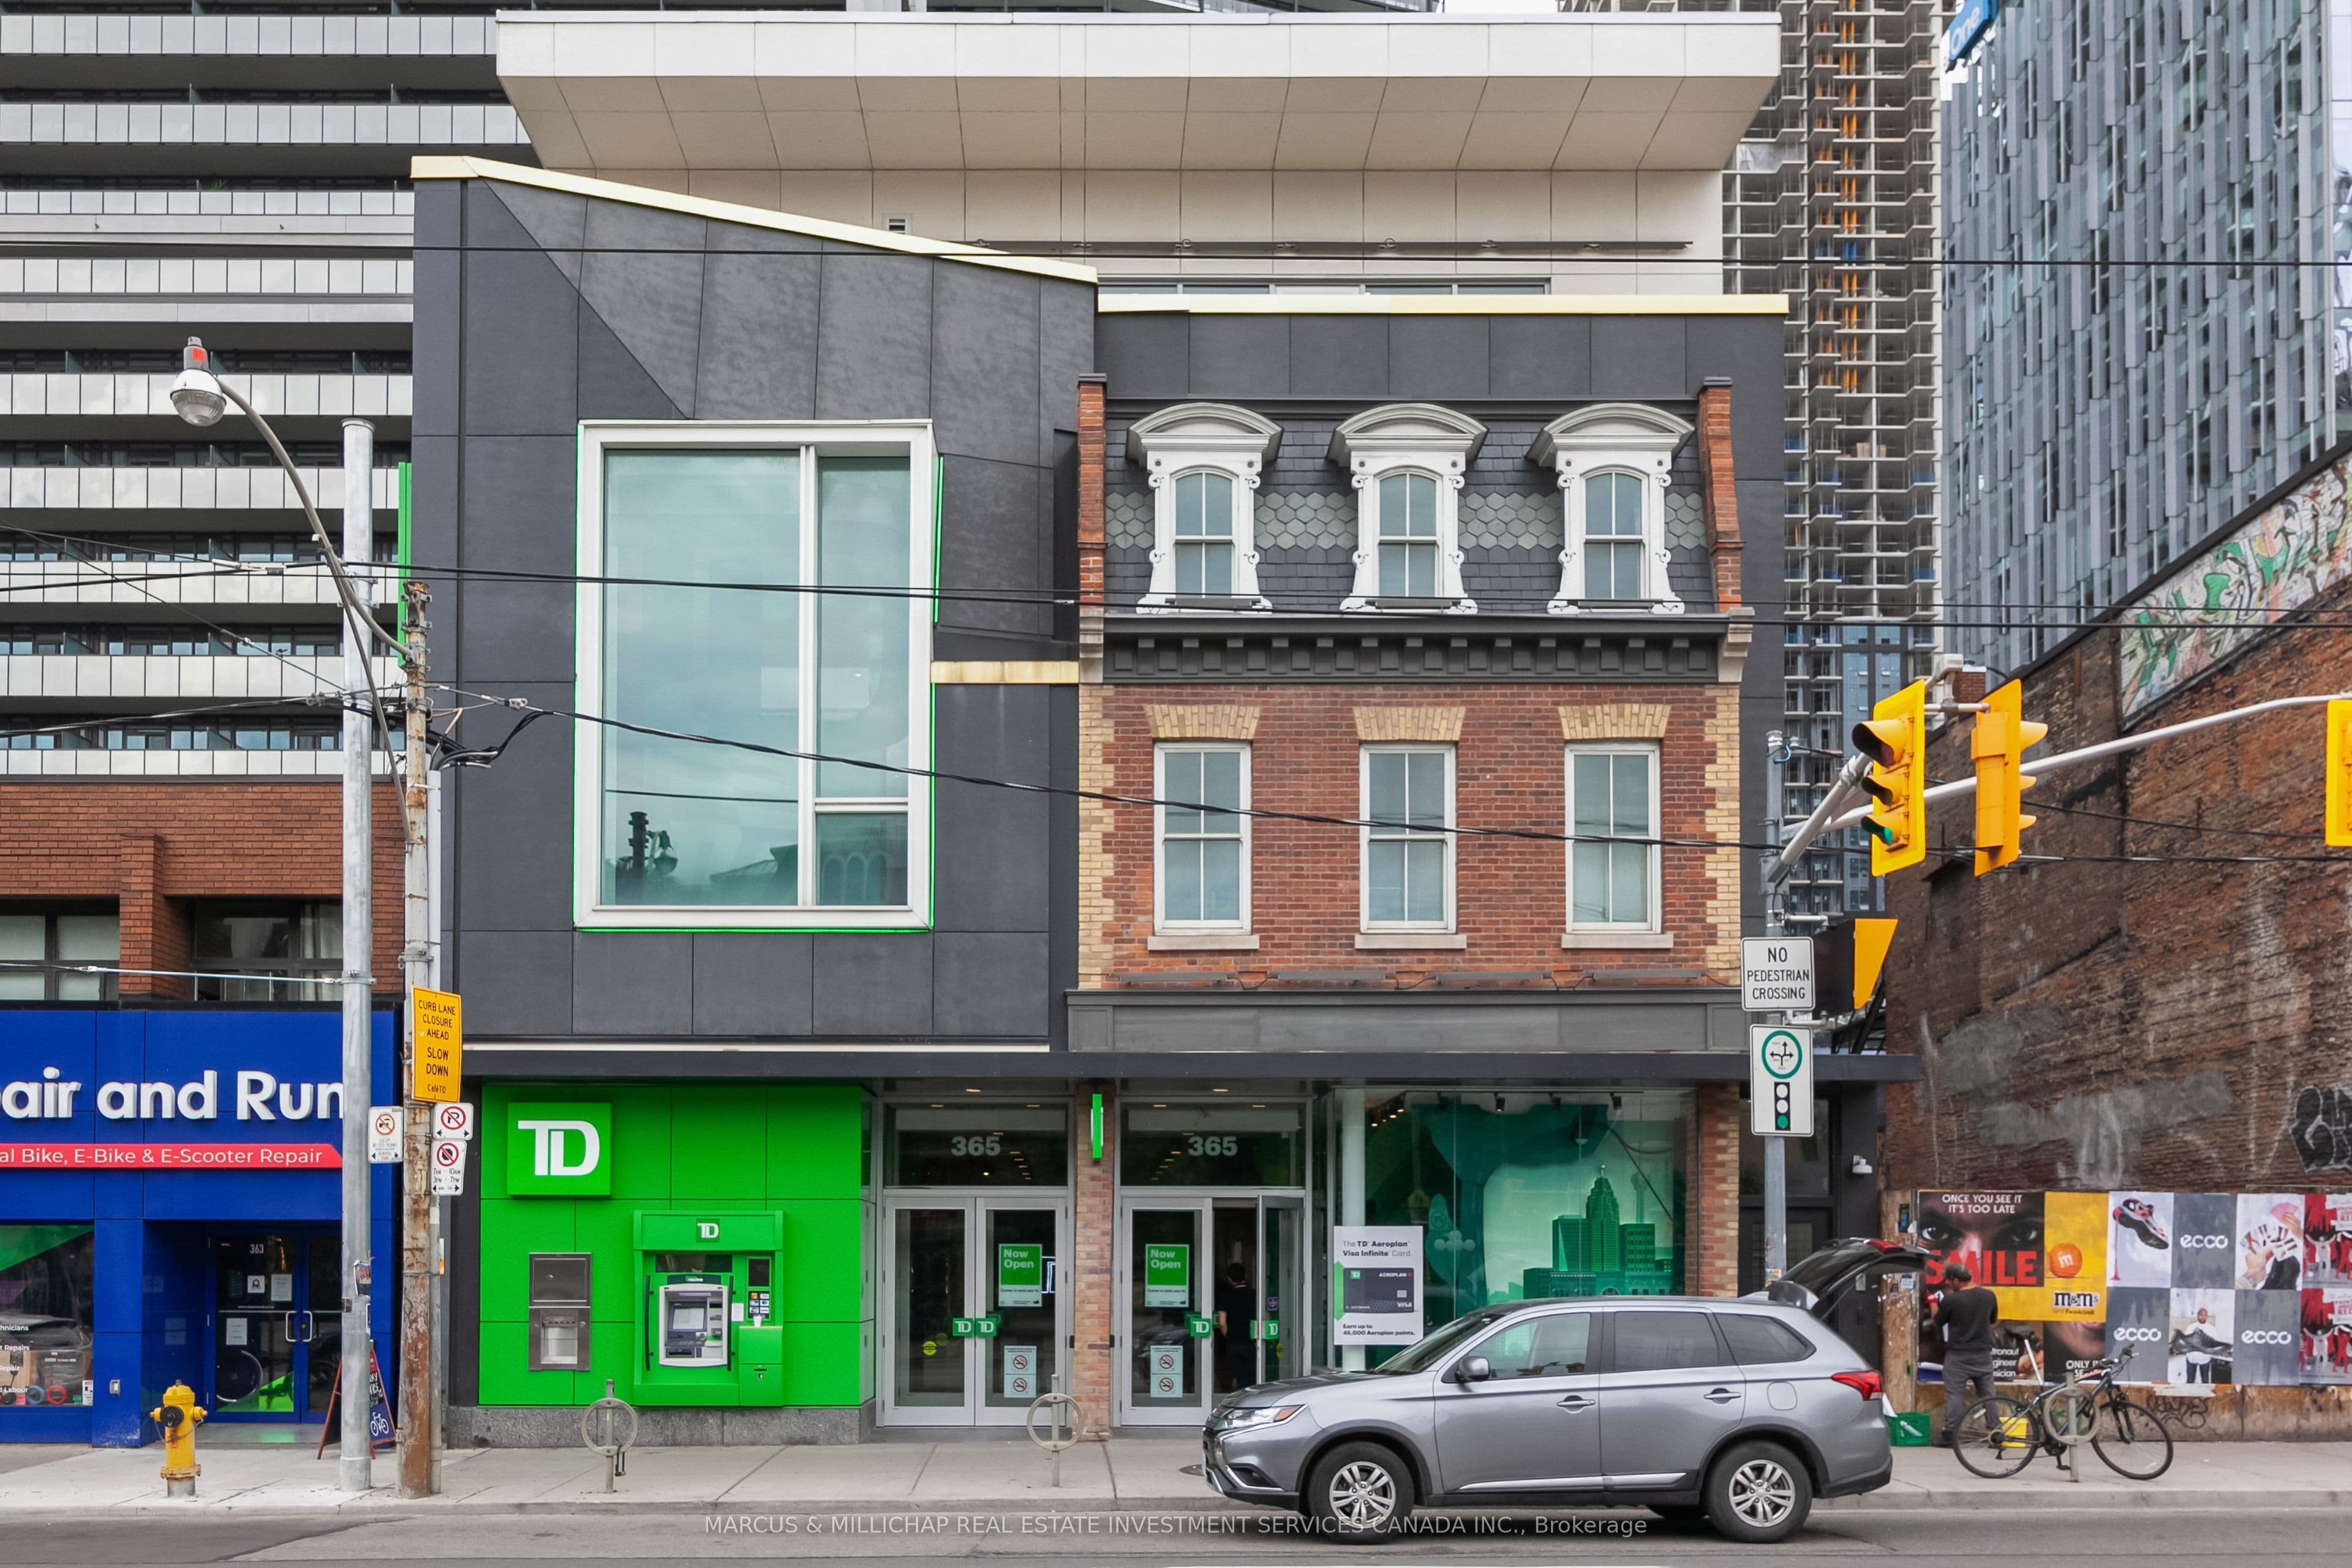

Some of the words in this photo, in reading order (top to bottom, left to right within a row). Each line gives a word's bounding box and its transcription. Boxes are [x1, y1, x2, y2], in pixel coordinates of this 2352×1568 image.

[1768, 948, 1787, 962] NO
[1747, 970, 1809, 982] PEDESTRIAN
[1752, 987, 1805, 1000] CROSSING
[418, 1000, 436, 1011] CURB
[438, 1005, 456, 1016] LANE
[423, 1014, 453, 1028] CLOSURE
[426, 1028, 449, 1040] AHEAD
[427, 1047, 448, 1060] SLOW
[426, 1063, 448, 1077] DOWN
[0, 1066, 81, 1118] air
[97, 1070, 217, 1119] and
[237, 1070, 343, 1120] Run
[518, 1120, 600, 1175] TD
[951, 1136, 1001, 1156] 365
[1188, 1136, 1238, 1156] 365
[22, 1149, 68, 1165] Bike,
[74, 1149, 135, 1163] E-Bike
[142, 1149, 154, 1163] &
[161, 1149, 252, 1163] E-Scooter
[260, 1149, 322, 1166] Repair
[1942, 1194, 1969, 1203] ONCE
[1973, 1194, 1993, 1203] YOU
[1996, 1194, 2011, 1204] SEE
[2014, 1195, 2022, 1204] IT
[1948, 1205, 1964, 1213] IT'S
[1968, 1205, 1990, 1213] TOO
[1994, 1205, 2015, 1213] LATE
[697, 1223, 719, 1238] TD
[2180, 1234, 2228, 1249] ecco
[250, 1244, 264, 1254] 363
[1004, 1249, 1029, 1258] Now
[1151, 1249, 1175, 1258] Now
[1004, 1259, 1034, 1270] Open
[1151, 1259, 1181, 1270] Open
[955, 1321, 971, 1333] TD
[978, 1321, 994, 1333] TD
[1193, 1321, 1210, 1333] TD
[1268, 1324, 1278, 1335] TD
[2113, 1327, 2162, 1341] ecco
[2241, 1330, 2292, 1344] ecco
[2066, 1360, 2090, 1370] ONLY
